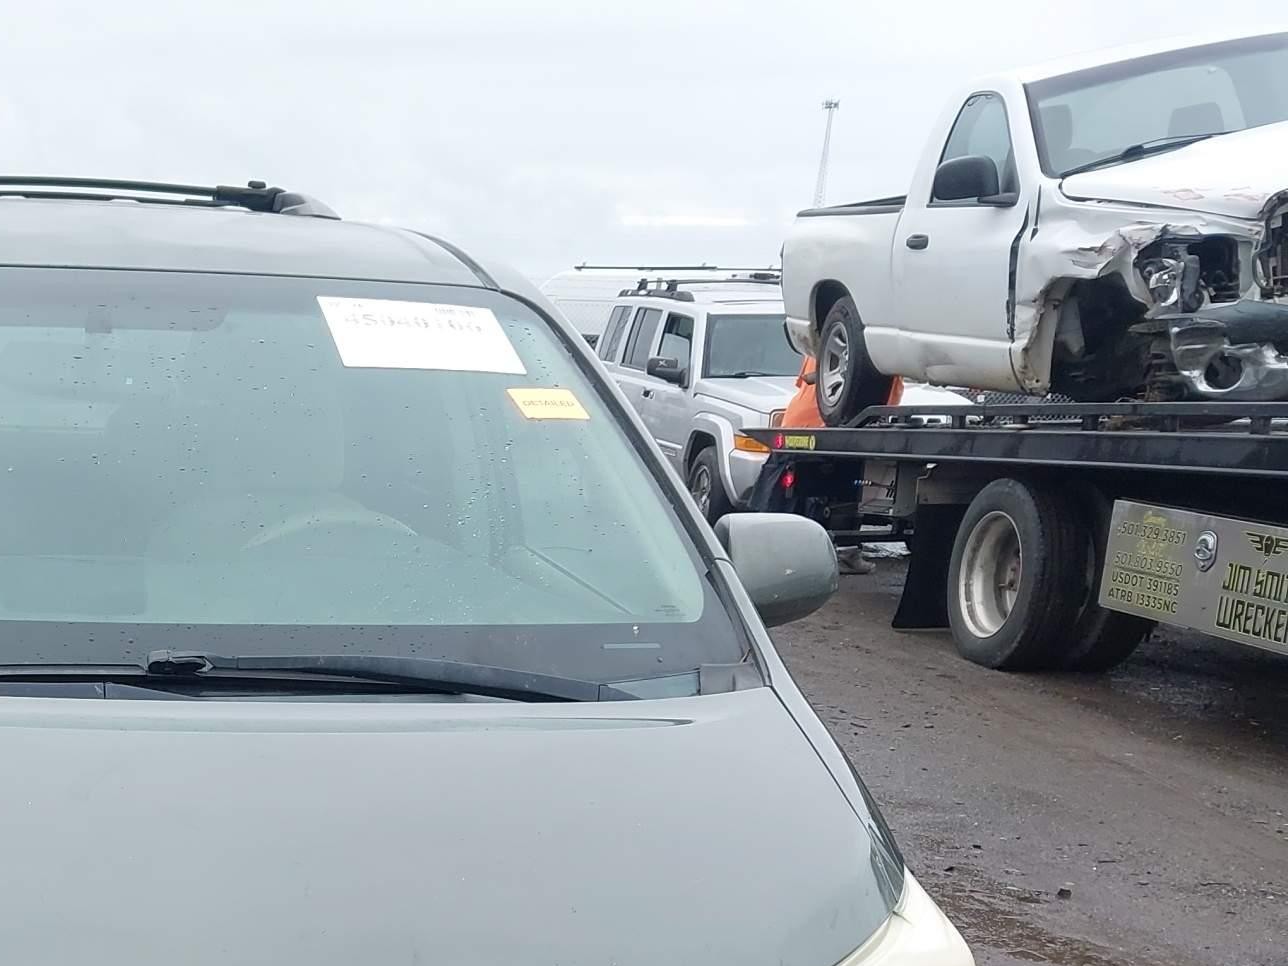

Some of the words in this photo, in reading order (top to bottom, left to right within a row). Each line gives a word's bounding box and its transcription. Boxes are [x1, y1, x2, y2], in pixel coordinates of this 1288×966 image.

[1112, 570, 1144, 587] USDOT
[1146, 578, 1180, 596] 391185
[1222, 562, 1252, 594] JIM
[1108, 587, 1133, 603] ATRB
